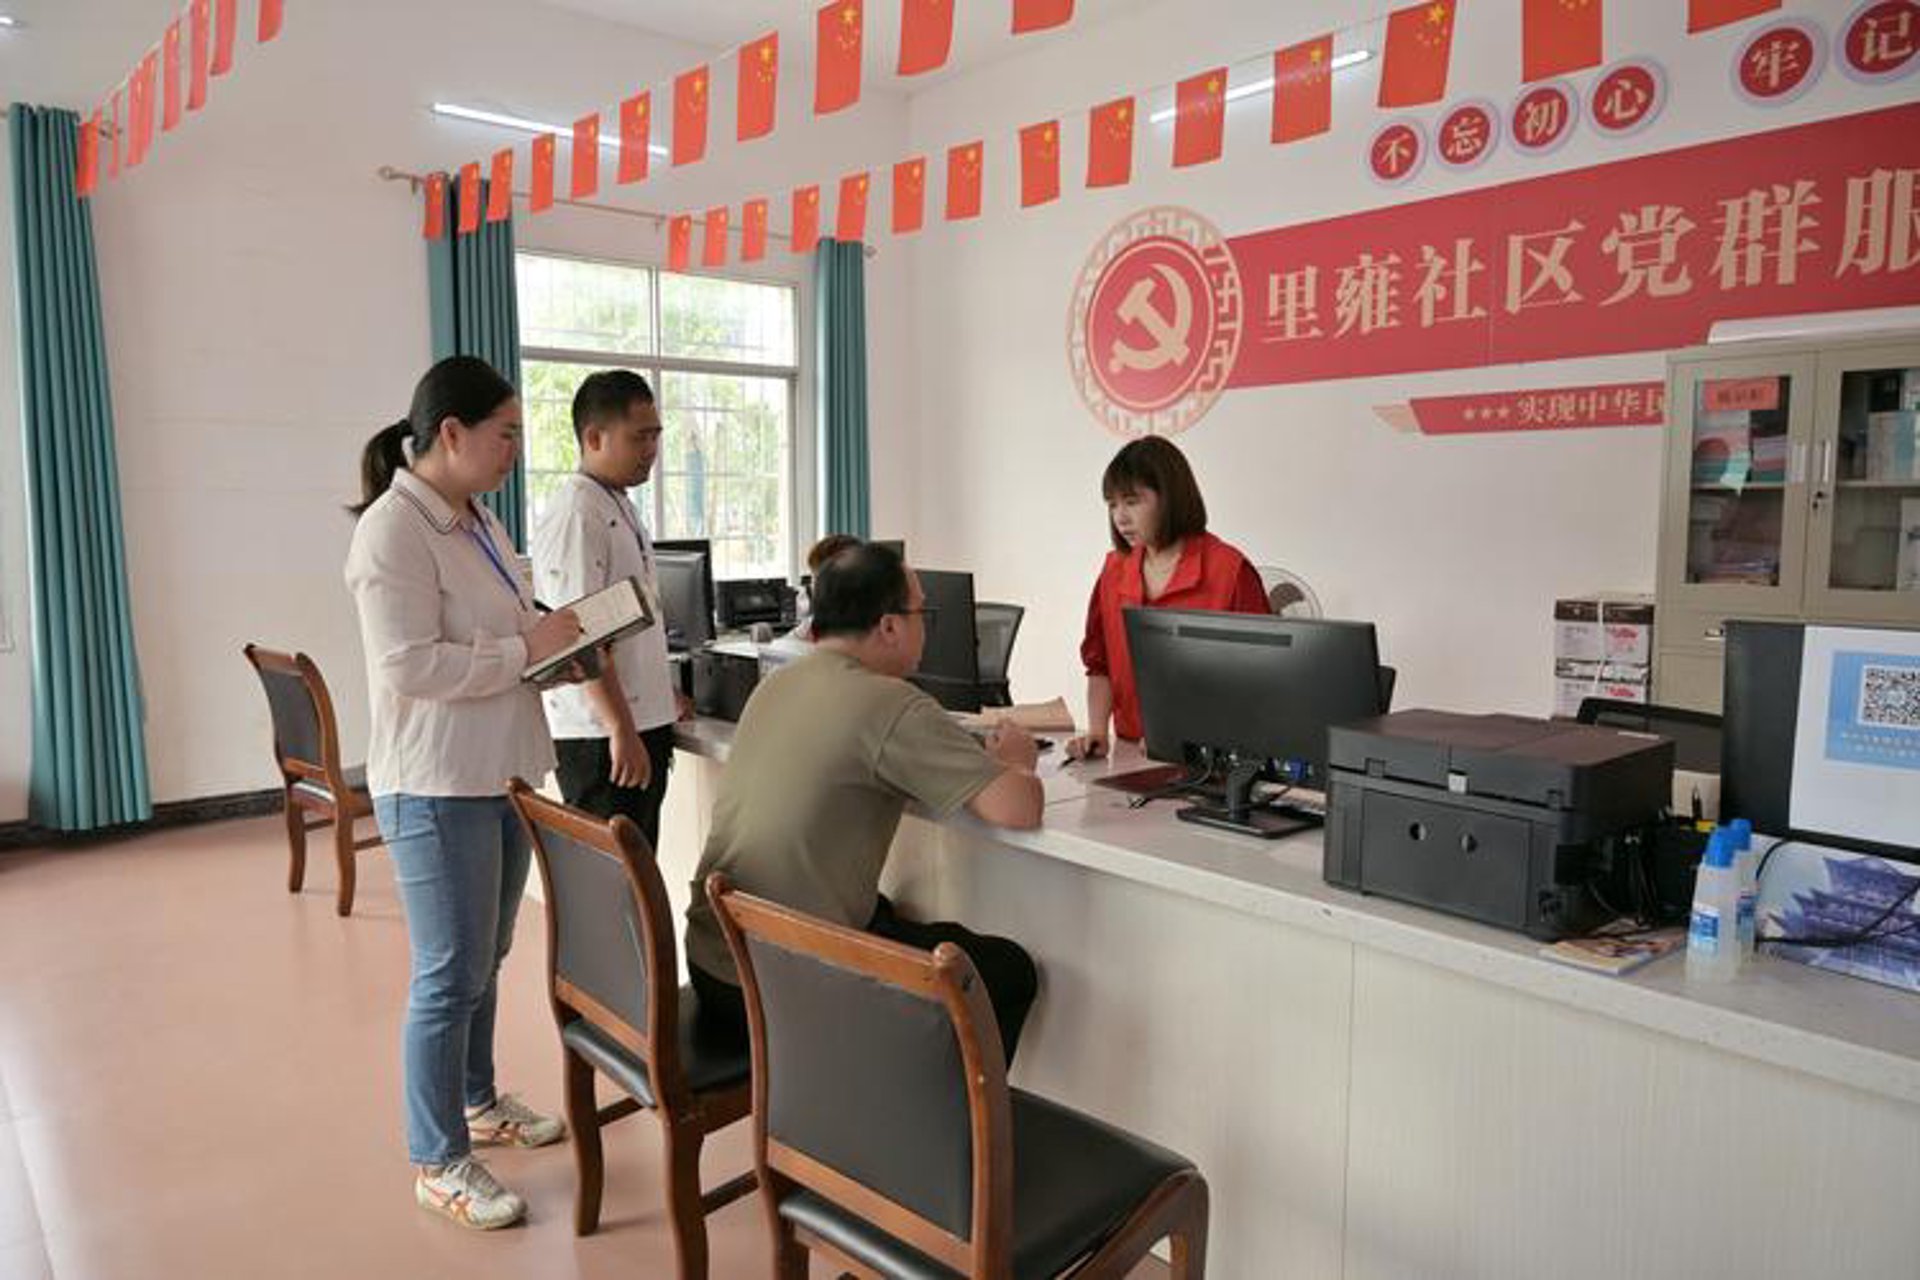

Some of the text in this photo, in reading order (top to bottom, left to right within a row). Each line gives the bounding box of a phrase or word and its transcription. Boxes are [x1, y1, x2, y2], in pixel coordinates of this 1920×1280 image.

[1380, 10, 1914, 174] 不忘初心 牢记
[1261, 167, 1920, 343] 里雍社区党群服
